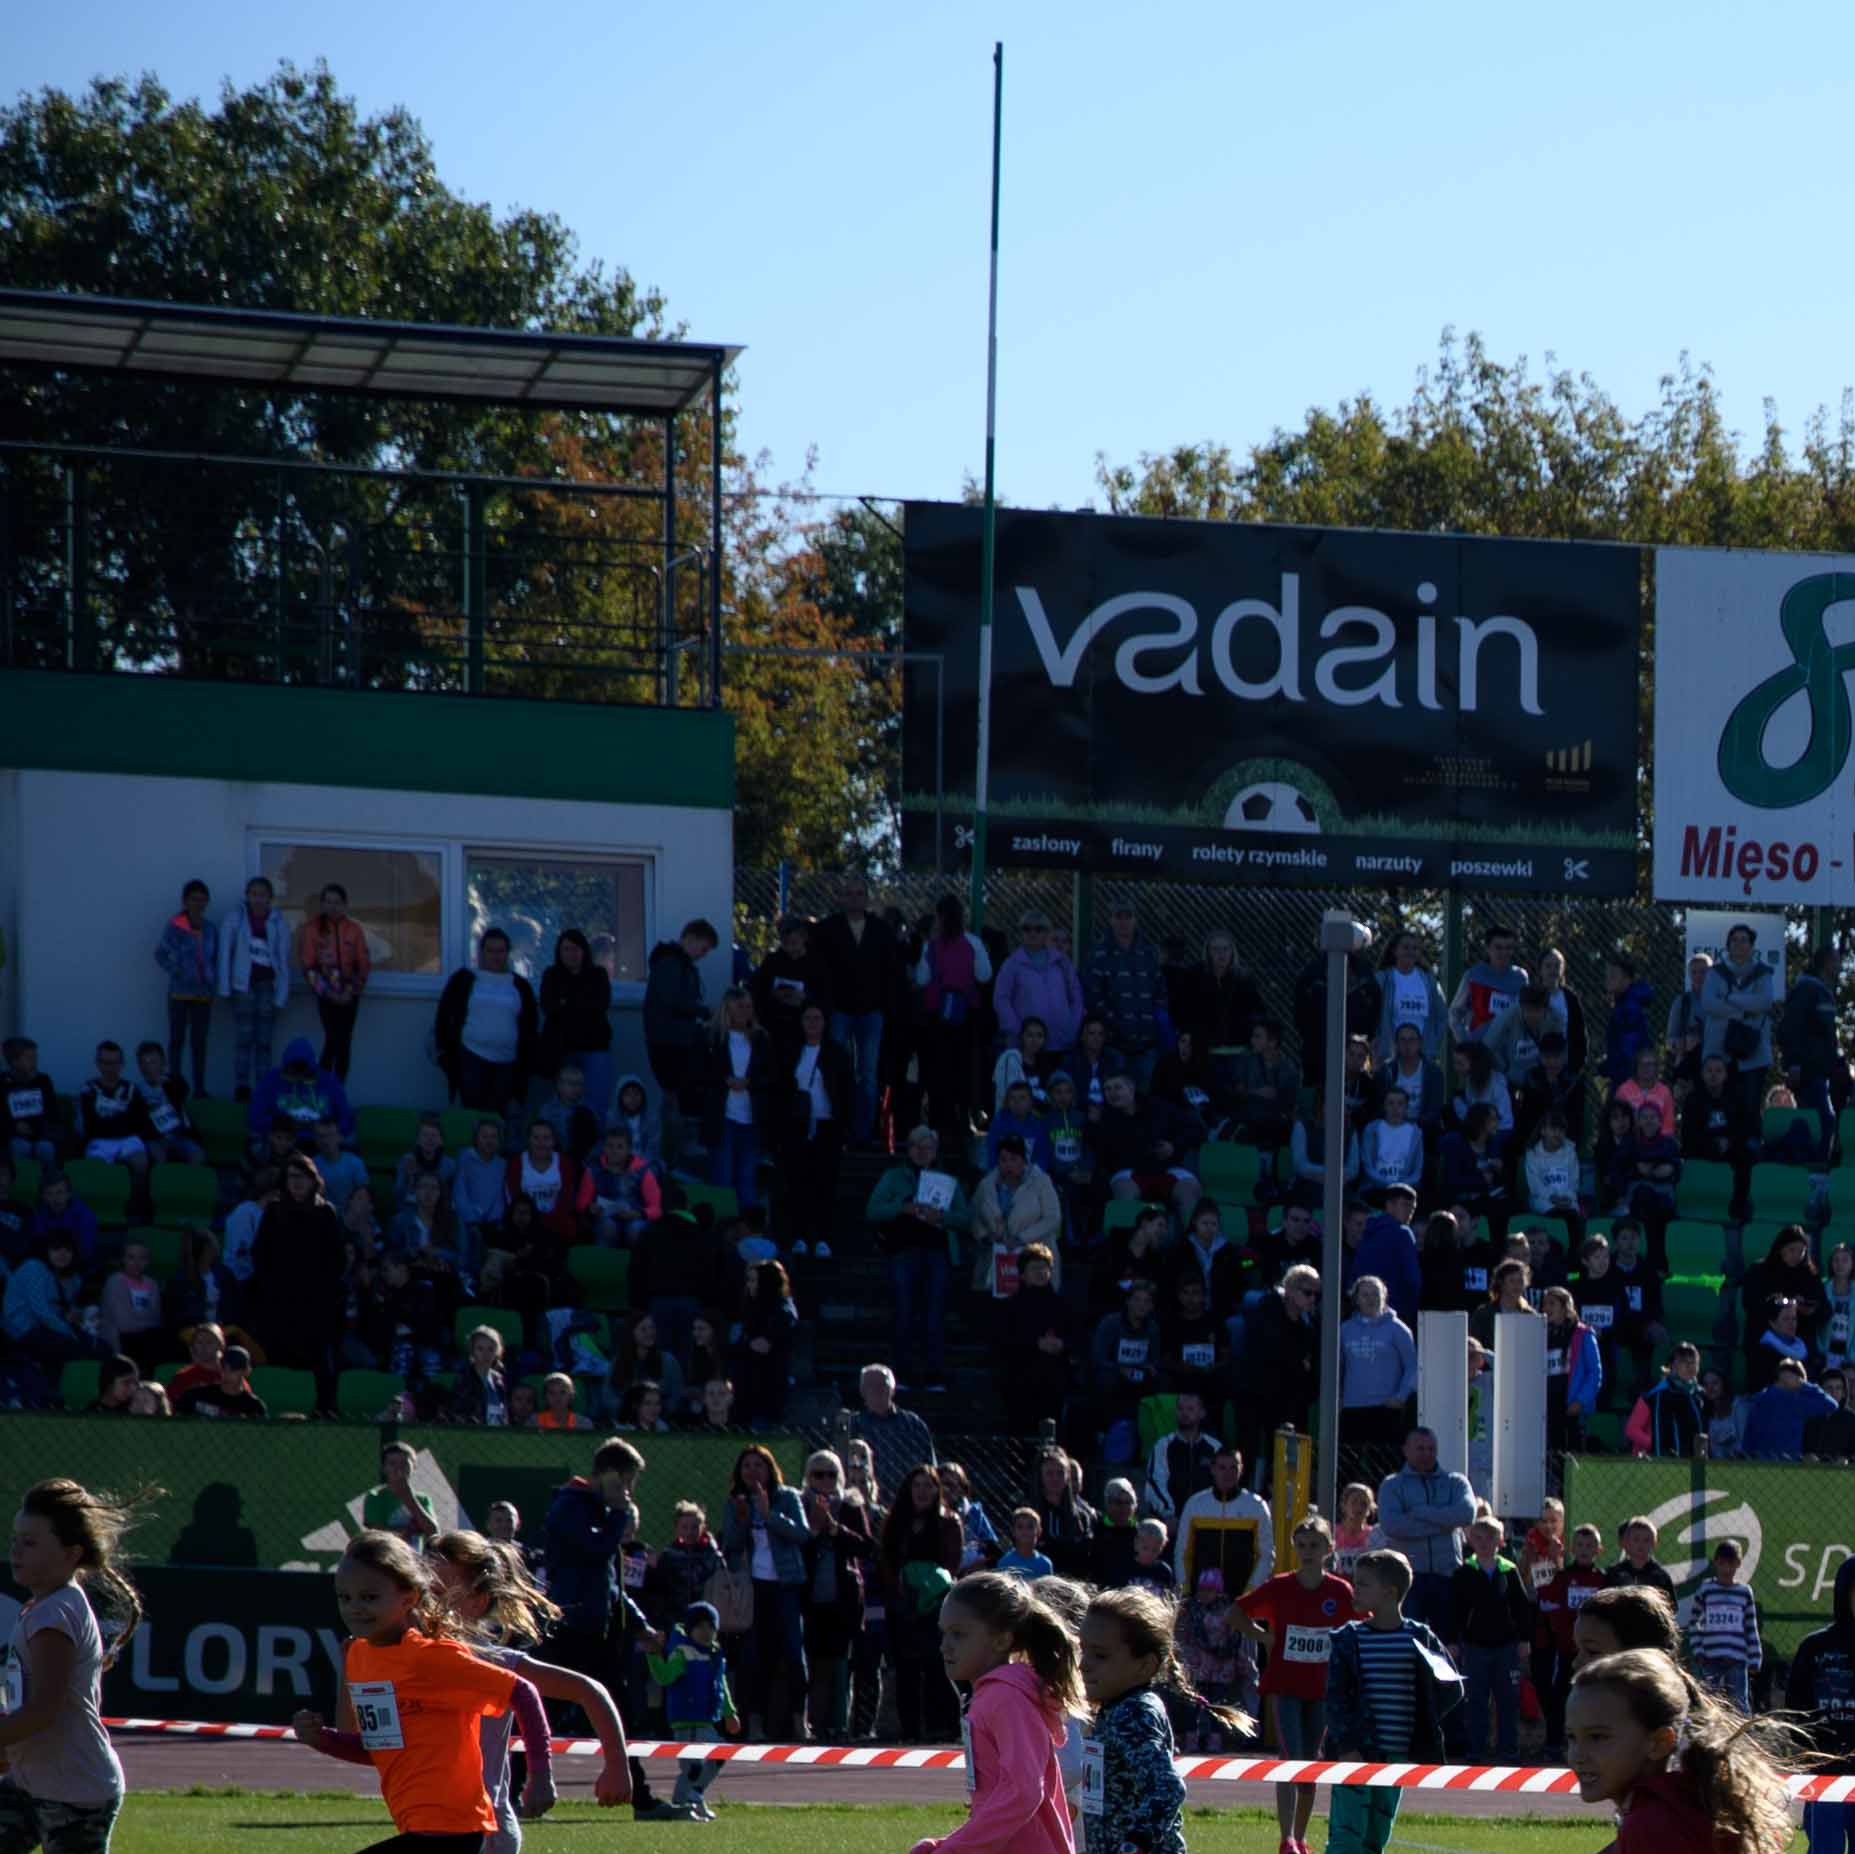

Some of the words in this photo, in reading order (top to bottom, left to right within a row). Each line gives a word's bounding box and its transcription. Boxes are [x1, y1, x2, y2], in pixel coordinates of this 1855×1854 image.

[1015, 573, 1545, 715] vadain
[1012, 832, 1080, 855] zasłony
[1112, 837, 1163, 860] firany
[1192, 842, 1244, 865] rolety
[1248, 846, 1327, 868] rzymskie
[1355, 852, 1422, 876] narzuty
[1451, 857, 1533, 880] poszewki
[1680, 826, 1818, 896] Mięso
